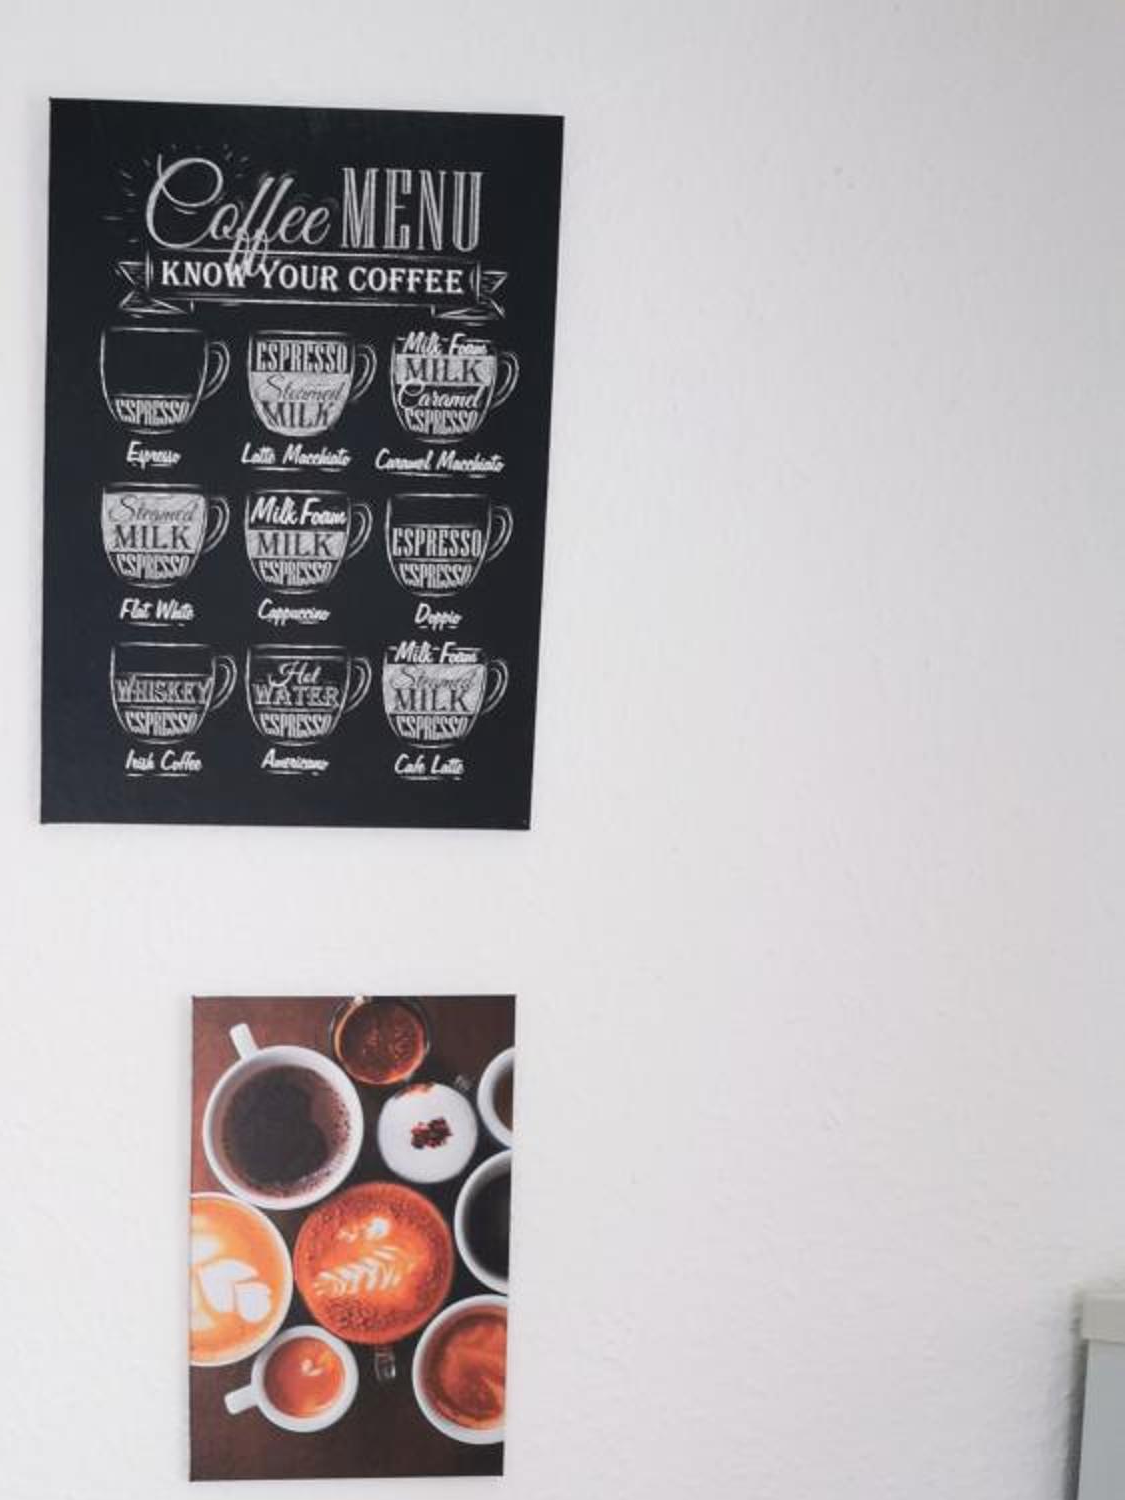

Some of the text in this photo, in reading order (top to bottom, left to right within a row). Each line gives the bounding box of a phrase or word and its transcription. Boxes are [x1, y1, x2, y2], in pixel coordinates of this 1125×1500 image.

[145, 153, 483, 277] Coffee MENU
[161, 261, 463, 295] KNOW YOUR COFFEE
[256, 341, 347, 373] ESPRESSO
[404, 358, 484, 383] MILK
[116, 400, 192, 426] ESPRESSO
[404, 408, 479, 435] ESPRESSO
[251, 496, 346, 526] Milk Foam
[114, 525, 192, 551] MILK
[258, 534, 335, 557] MILK
[392, 527, 482, 557] ESPRESSO
[116, 552, 191, 579] ESPRESSO
[258, 559, 334, 586] ESPRESSO
[398, 562, 474, 589] ESPRESSO
[414, 602, 463, 630] Doppio
[394, 641, 432, 664] Milk
[116, 677, 215, 705] WHISKEY
[253, 683, 340, 708] WATER
[395, 690, 470, 713] MILK
[124, 710, 198, 738] ESPRESSO
[259, 713, 331, 740] ESPRESSO
[396, 715, 469, 741] ESPRESSO
[160, 749, 203, 771] Coffee
